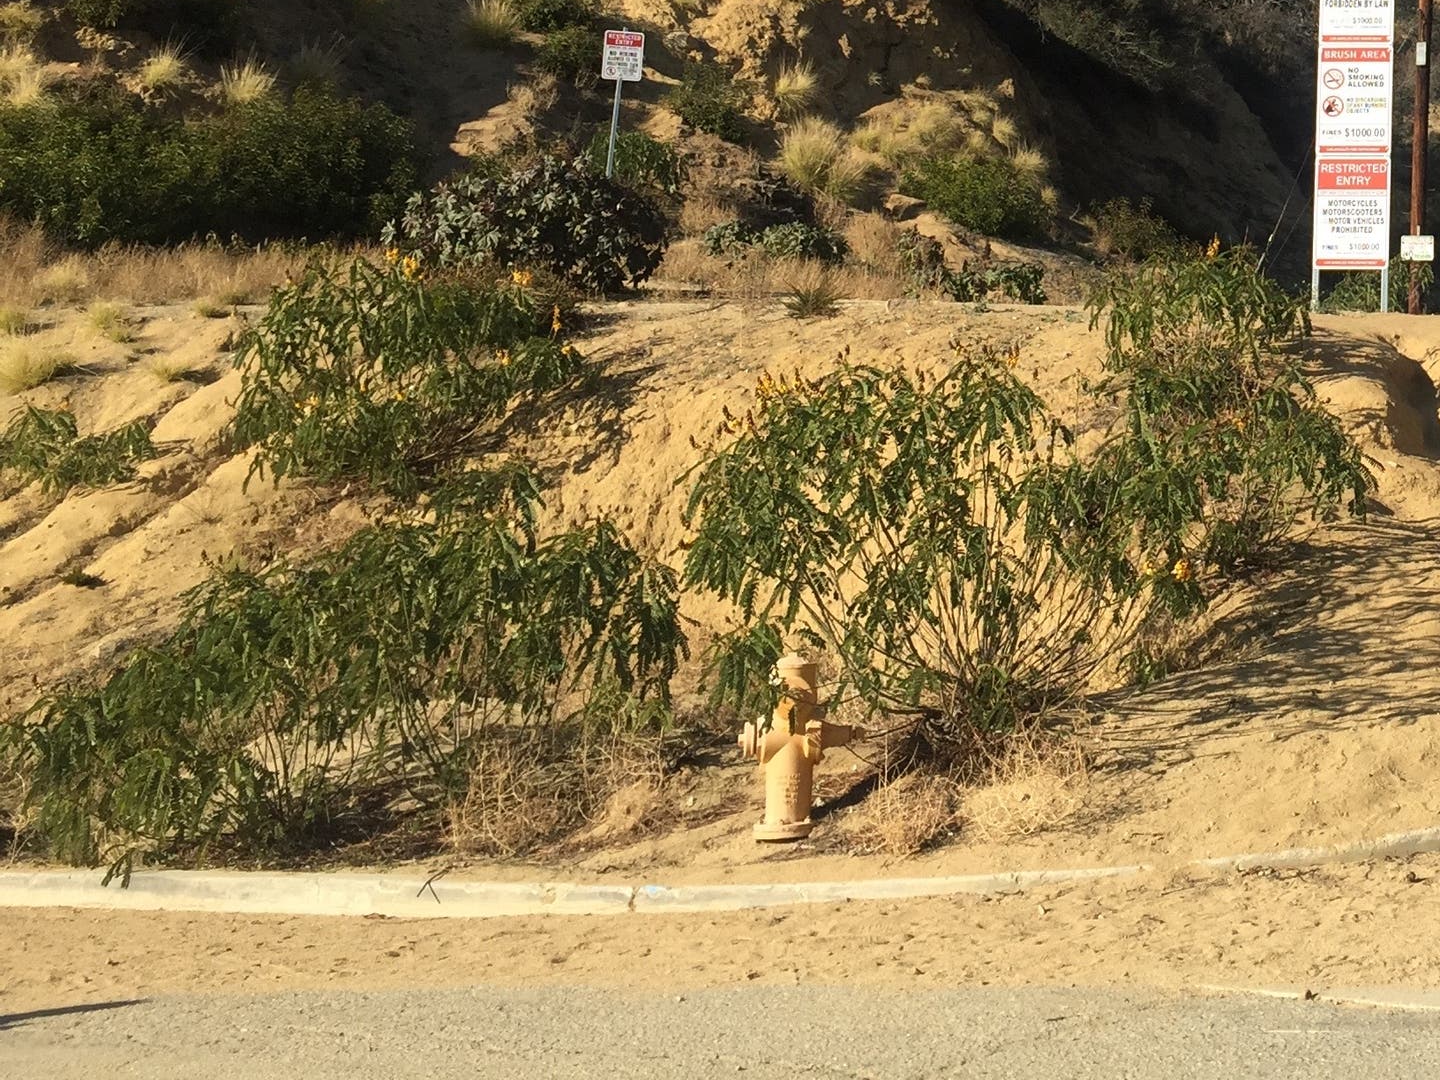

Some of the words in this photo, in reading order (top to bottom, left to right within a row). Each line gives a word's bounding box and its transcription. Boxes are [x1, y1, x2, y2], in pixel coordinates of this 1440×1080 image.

[1325, 0, 1362, 8] FORBIDDEN
[1364, 0, 1373, 8] BY
[1374, 0, 1389, 8] LAW
[1324, 50, 1357, 59] BRUSH
[1360, 50, 1387, 59] AREA
[1321, 163, 1387, 173] RESTRICTED
[1336, 176, 1371, 186] ENTRY
[1328, 199, 1378, 207] MOTORCYCLES
[1322, 208, 1383, 216] MOTORSCOOTERS
[1328, 217, 1351, 225] MOTOR
[1352, 217, 1385, 225] VEHICLES
[1331, 226, 1373, 234] PROHIBITED
